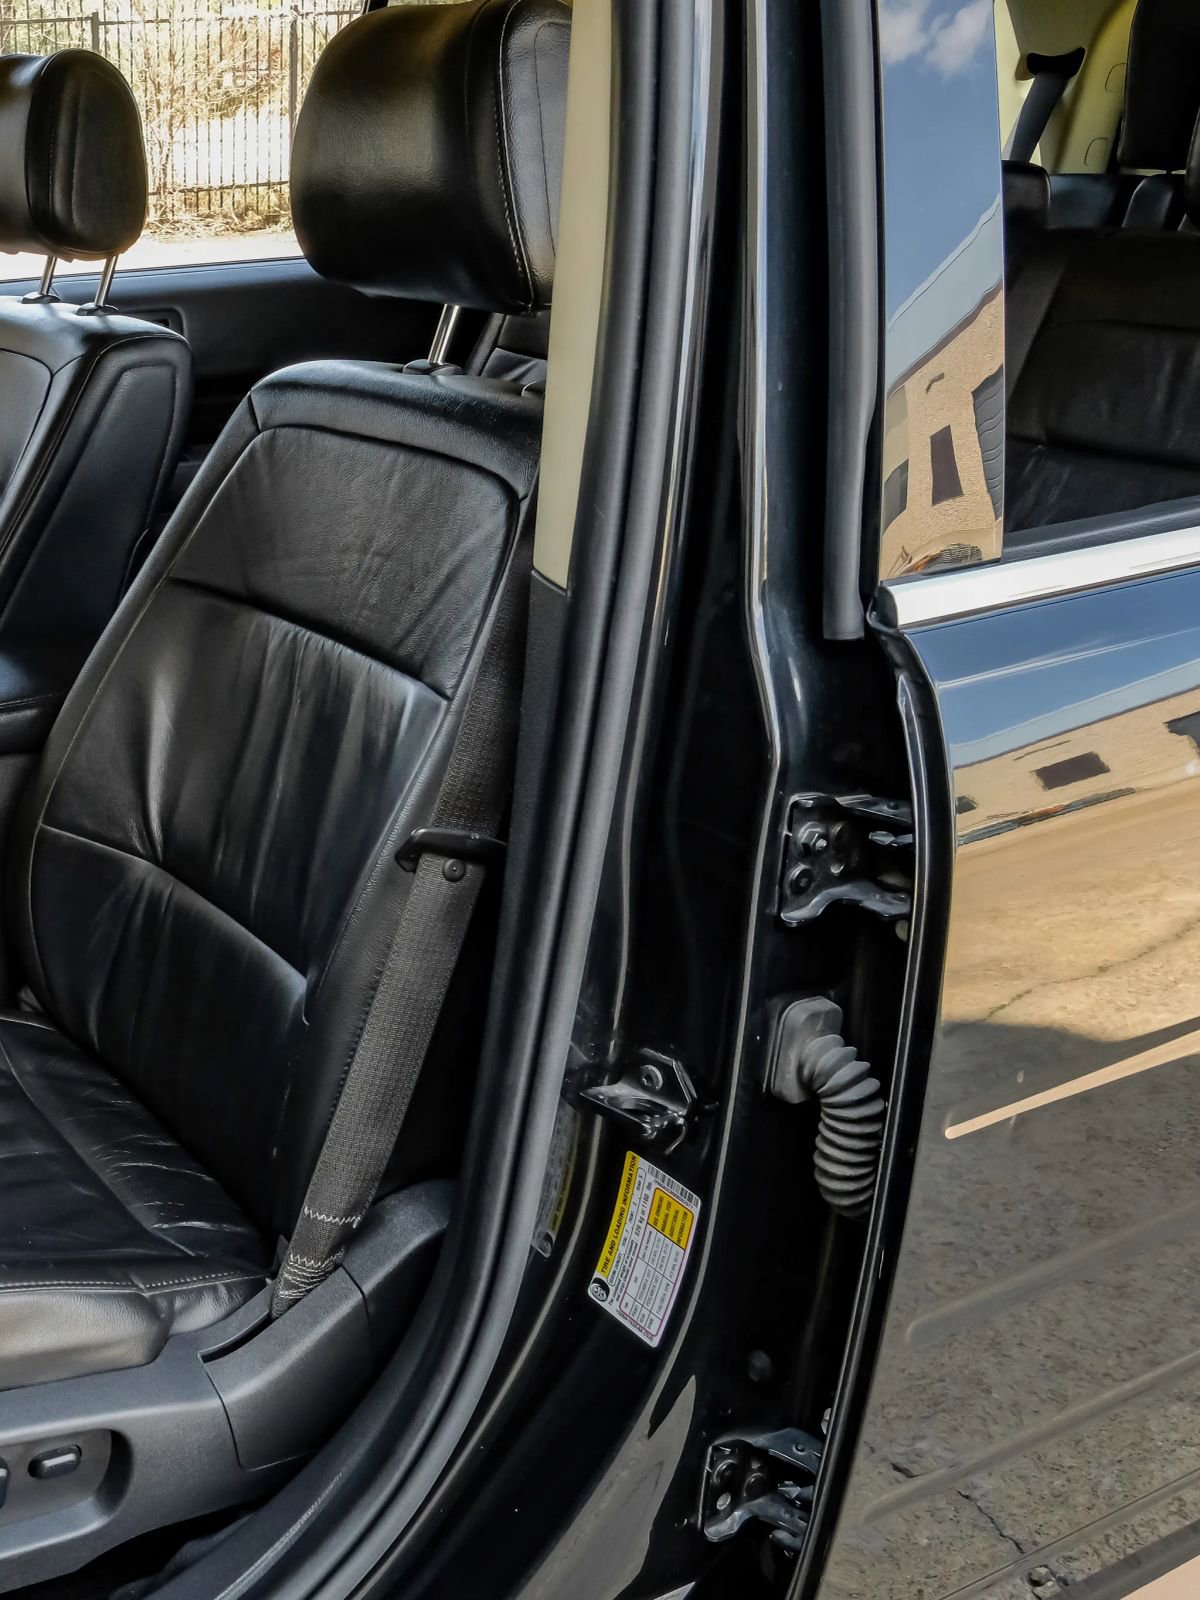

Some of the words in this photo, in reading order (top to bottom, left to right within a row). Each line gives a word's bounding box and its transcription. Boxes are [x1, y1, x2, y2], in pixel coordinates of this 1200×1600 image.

[601, 1256, 610, 1274] TIRE
[613, 1208, 626, 1238] LOADING
[622, 1155, 636, 1206] INFORMATION
[661, 1213, 670, 1232] MANUAL
[669, 1209, 679, 1238] ADDITIONAL
[677, 1211, 688, 1244] INFORMATION
